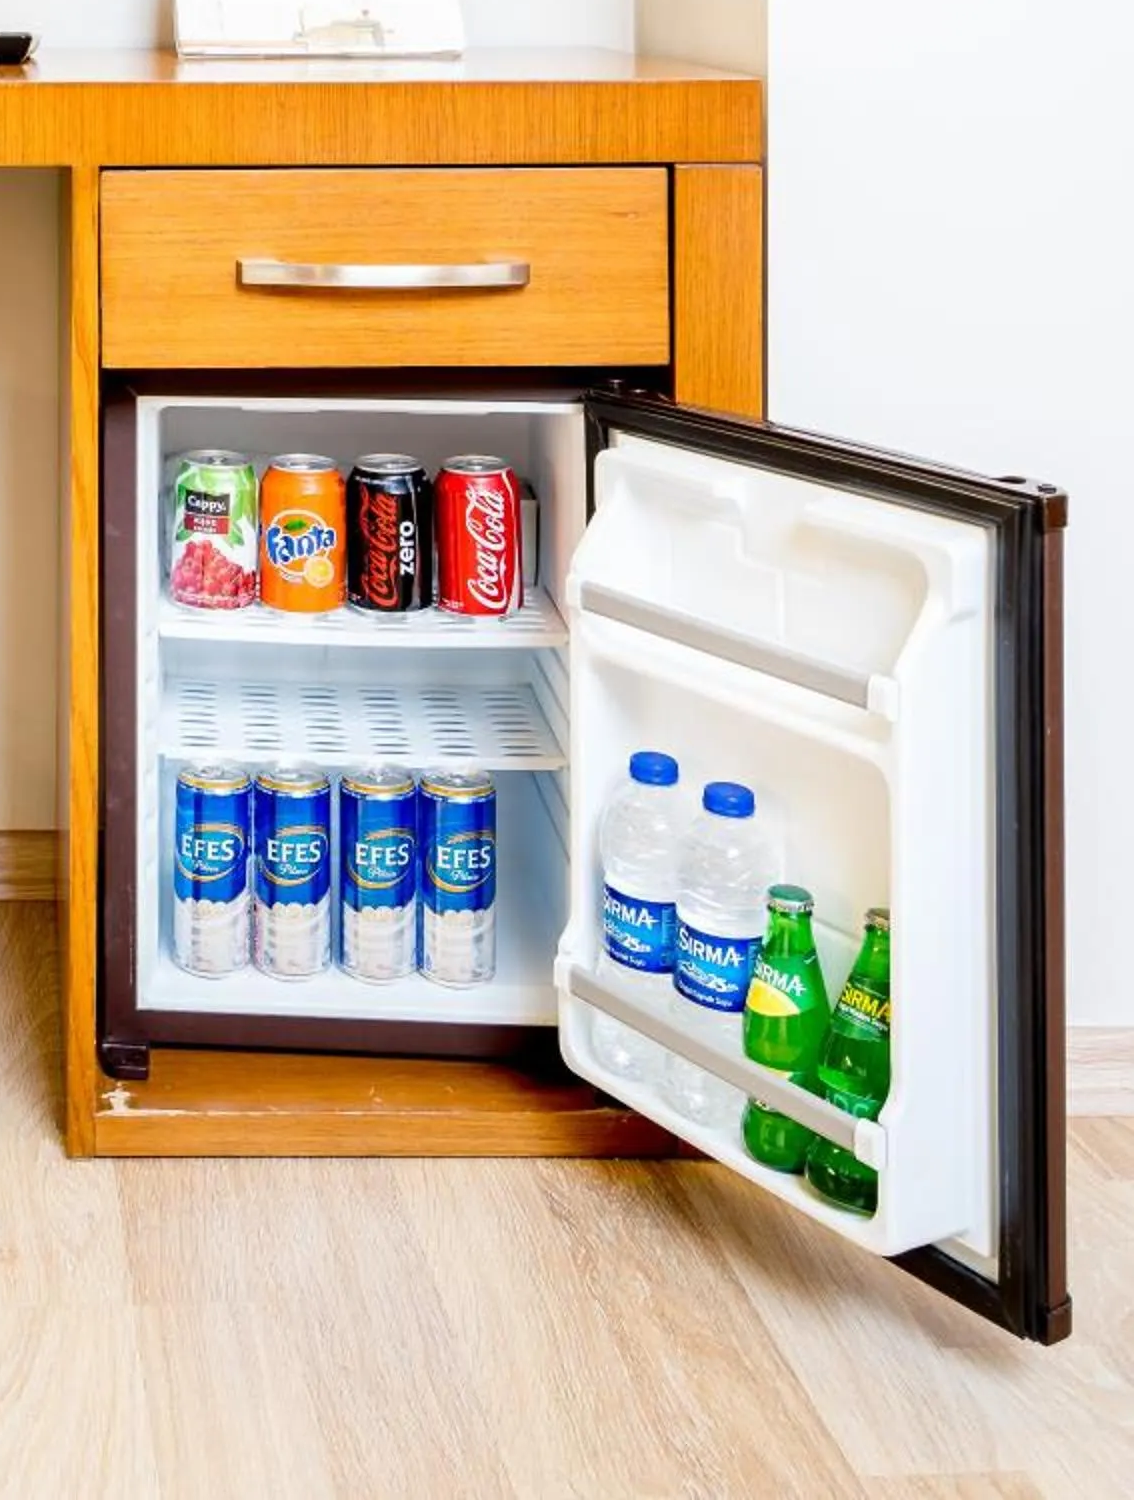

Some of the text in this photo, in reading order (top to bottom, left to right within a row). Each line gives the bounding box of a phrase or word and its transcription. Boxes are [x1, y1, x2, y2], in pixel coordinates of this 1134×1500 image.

[187, 494, 224, 514] Cappy
[266, 524, 336, 566] Fanta
[399, 520, 415, 576] zero
[181, 833, 236, 862] EFES
[267, 838, 322, 864] EFES
[355, 843, 410, 867] EFES
[436, 845, 491, 870] EFES
[678, 926, 745, 968] SIRMA
